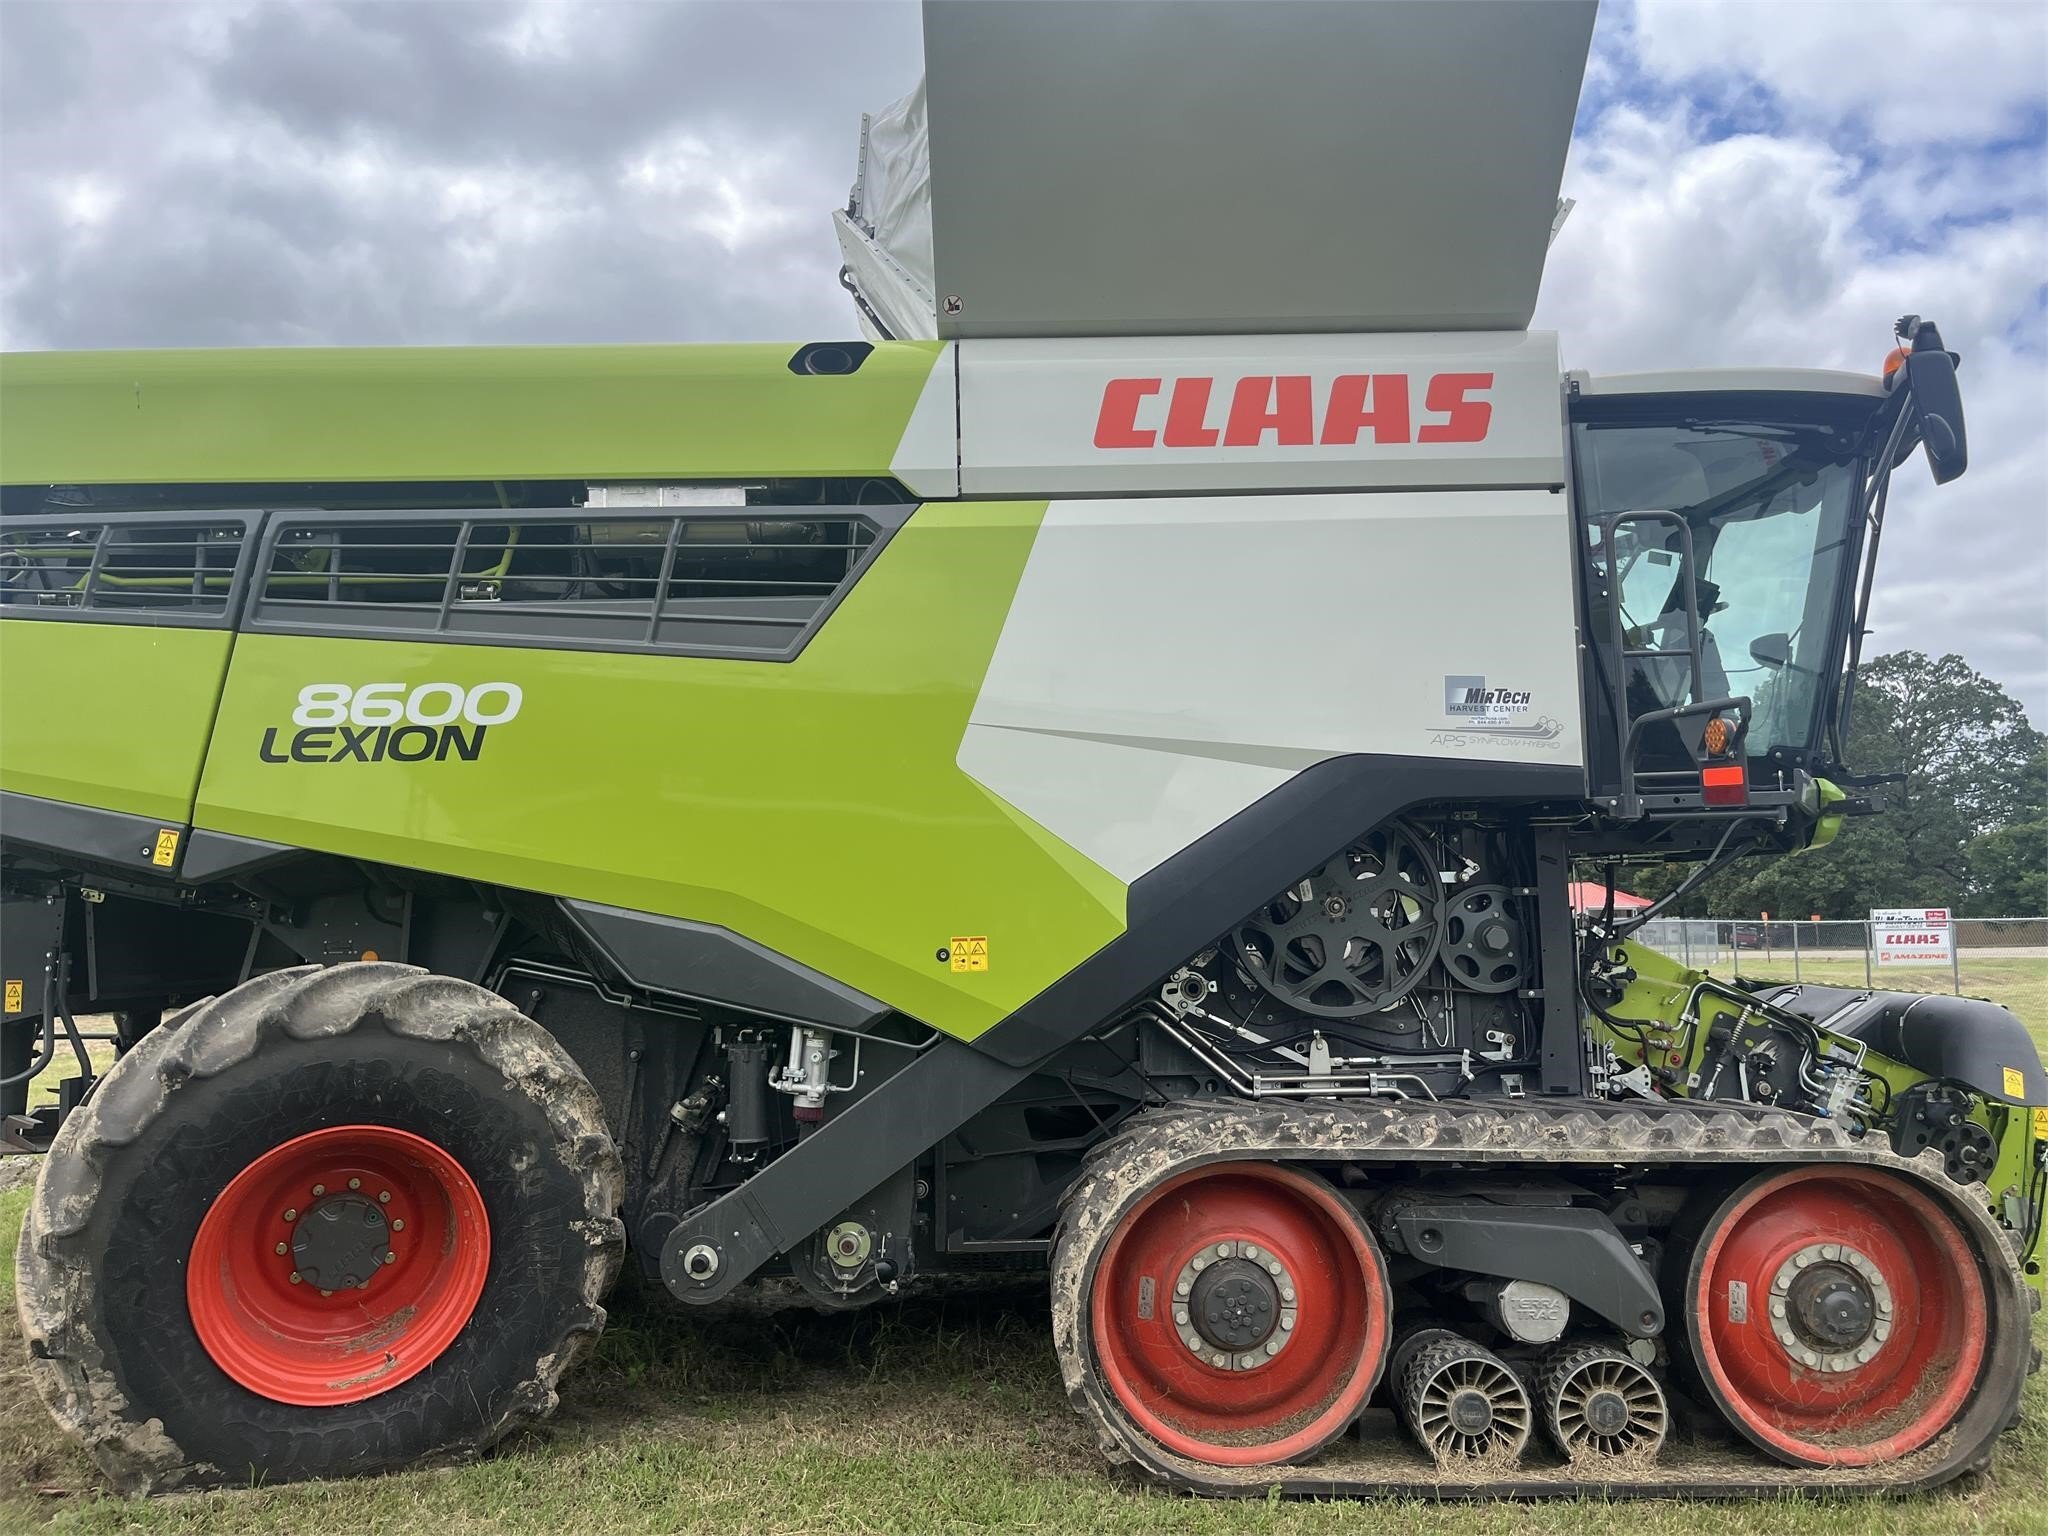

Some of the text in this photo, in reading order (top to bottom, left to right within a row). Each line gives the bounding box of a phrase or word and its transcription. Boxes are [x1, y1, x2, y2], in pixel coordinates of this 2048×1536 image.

[1093, 373, 1494, 449] CLAAS
[292, 682, 523, 727] 8600
[1493, 705, 1528, 713] CENTER
[259, 725, 487, 763] LEXION
[1430, 734, 1561, 750] APS SYNFLOW HYBRID
[1886, 935, 1939, 944] CLAAS
[1511, 1297, 1561, 1309] TERRA
[1516, 1309, 1560, 1320] TRAC
